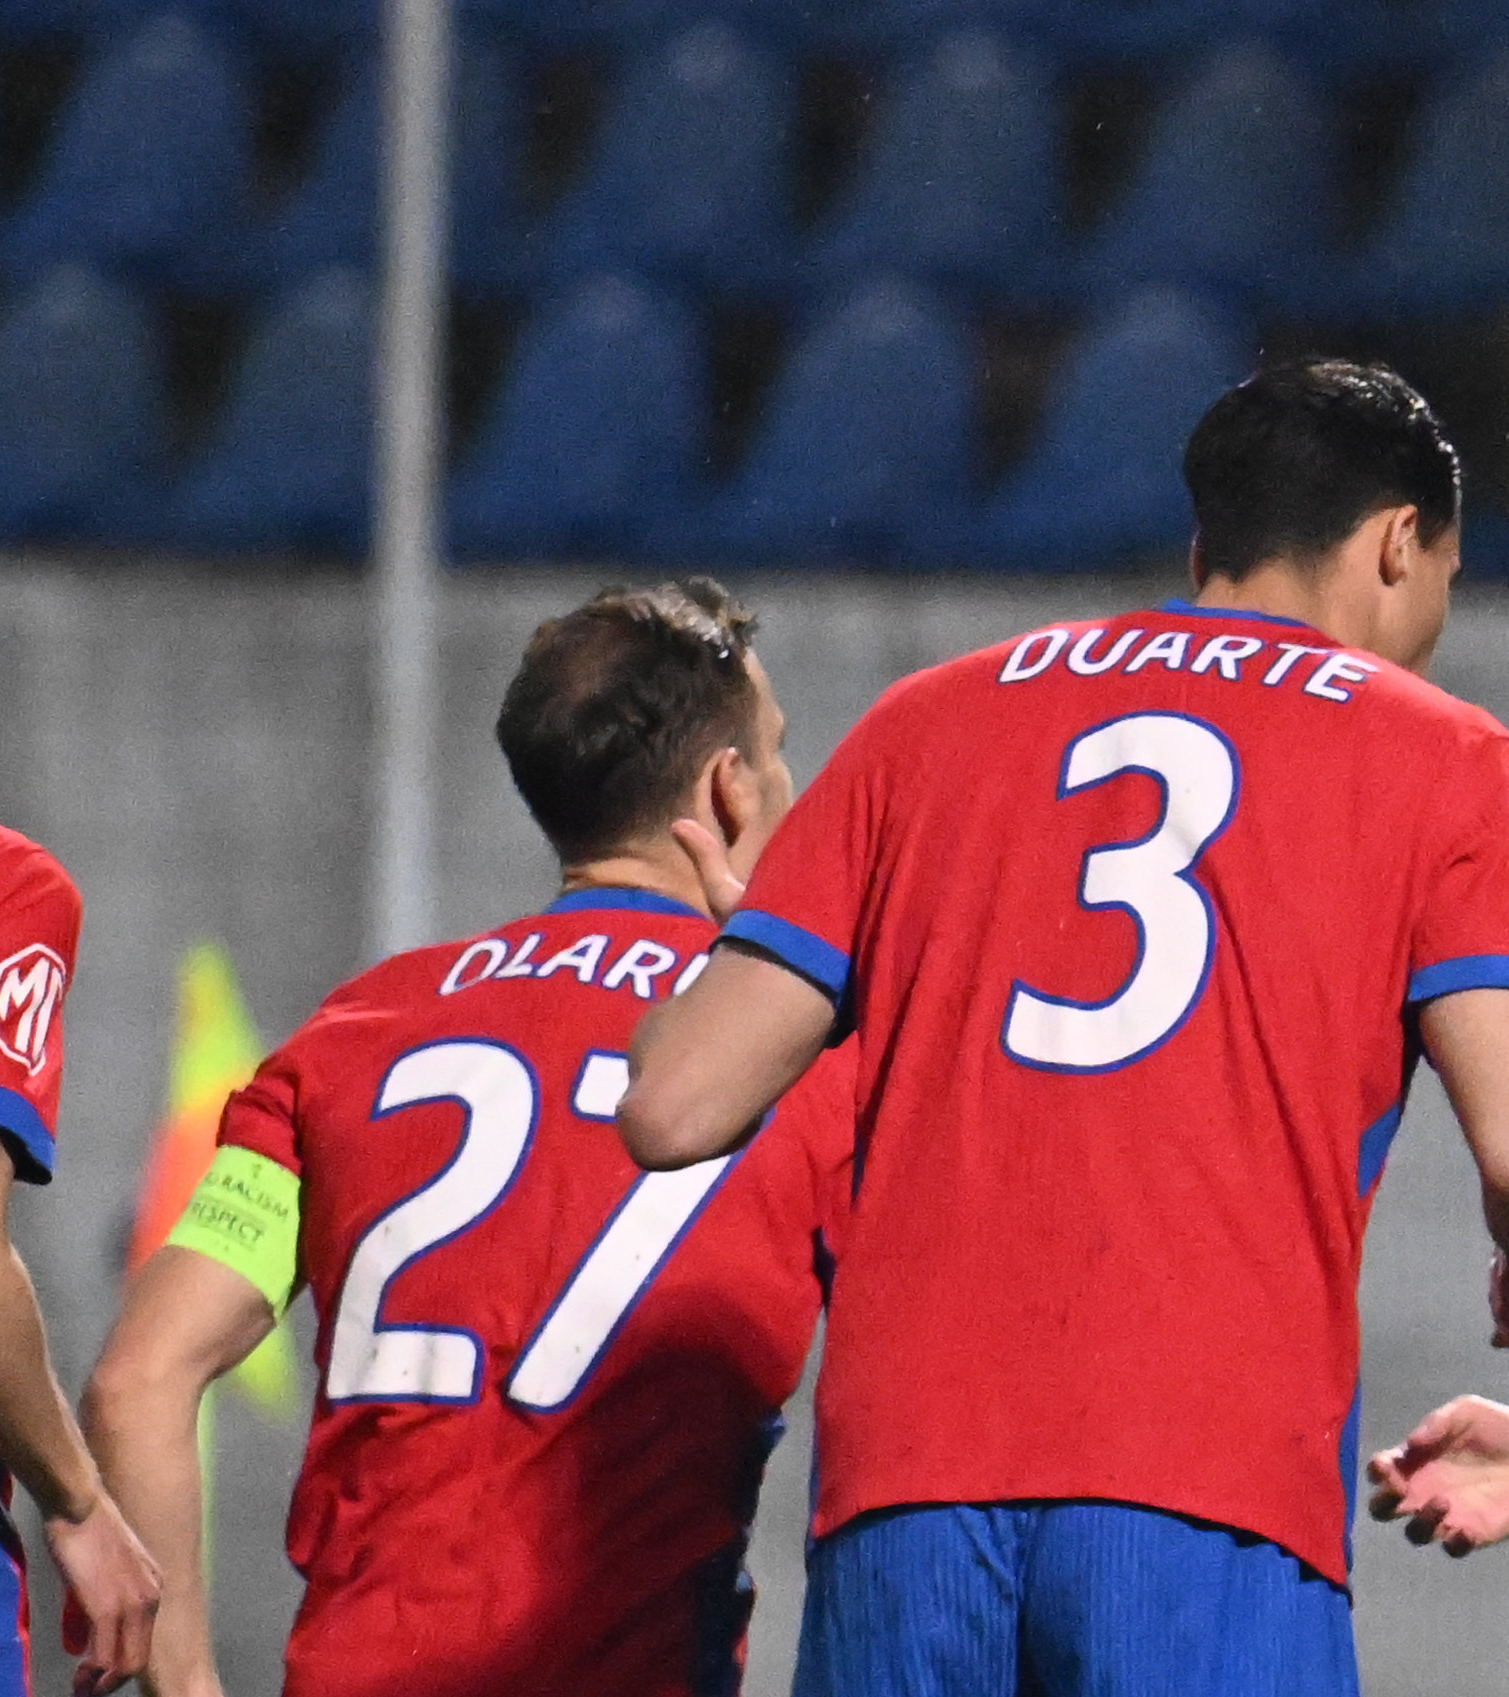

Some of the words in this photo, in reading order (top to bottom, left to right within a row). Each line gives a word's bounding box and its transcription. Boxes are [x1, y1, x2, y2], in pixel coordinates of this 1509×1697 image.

[998, 627, 1378, 703] DUARTE
[437, 930, 712, 1000] OLAR
[1000, 709, 1241, 1075] 3
[323, 1035, 776, 1415] 27
